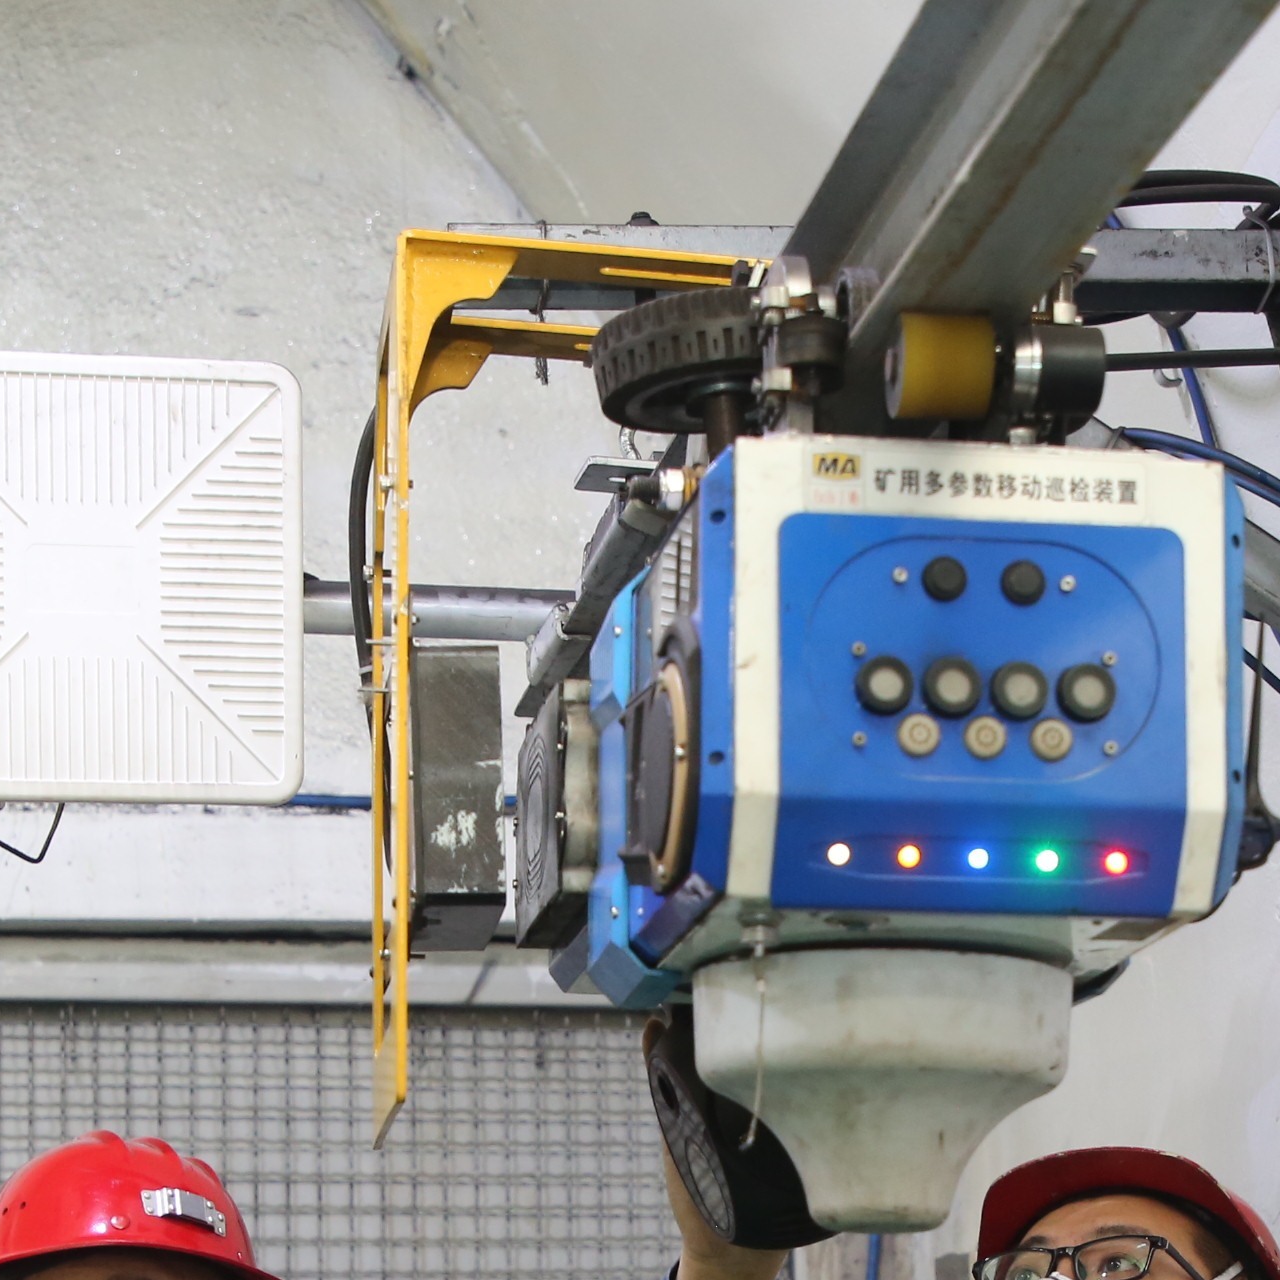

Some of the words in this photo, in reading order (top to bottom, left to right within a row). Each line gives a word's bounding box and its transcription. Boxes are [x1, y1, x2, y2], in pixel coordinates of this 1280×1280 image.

[817, 456, 857, 476] MA
[874, 468, 1138, 505] 矿用多参数移动巡检装置
